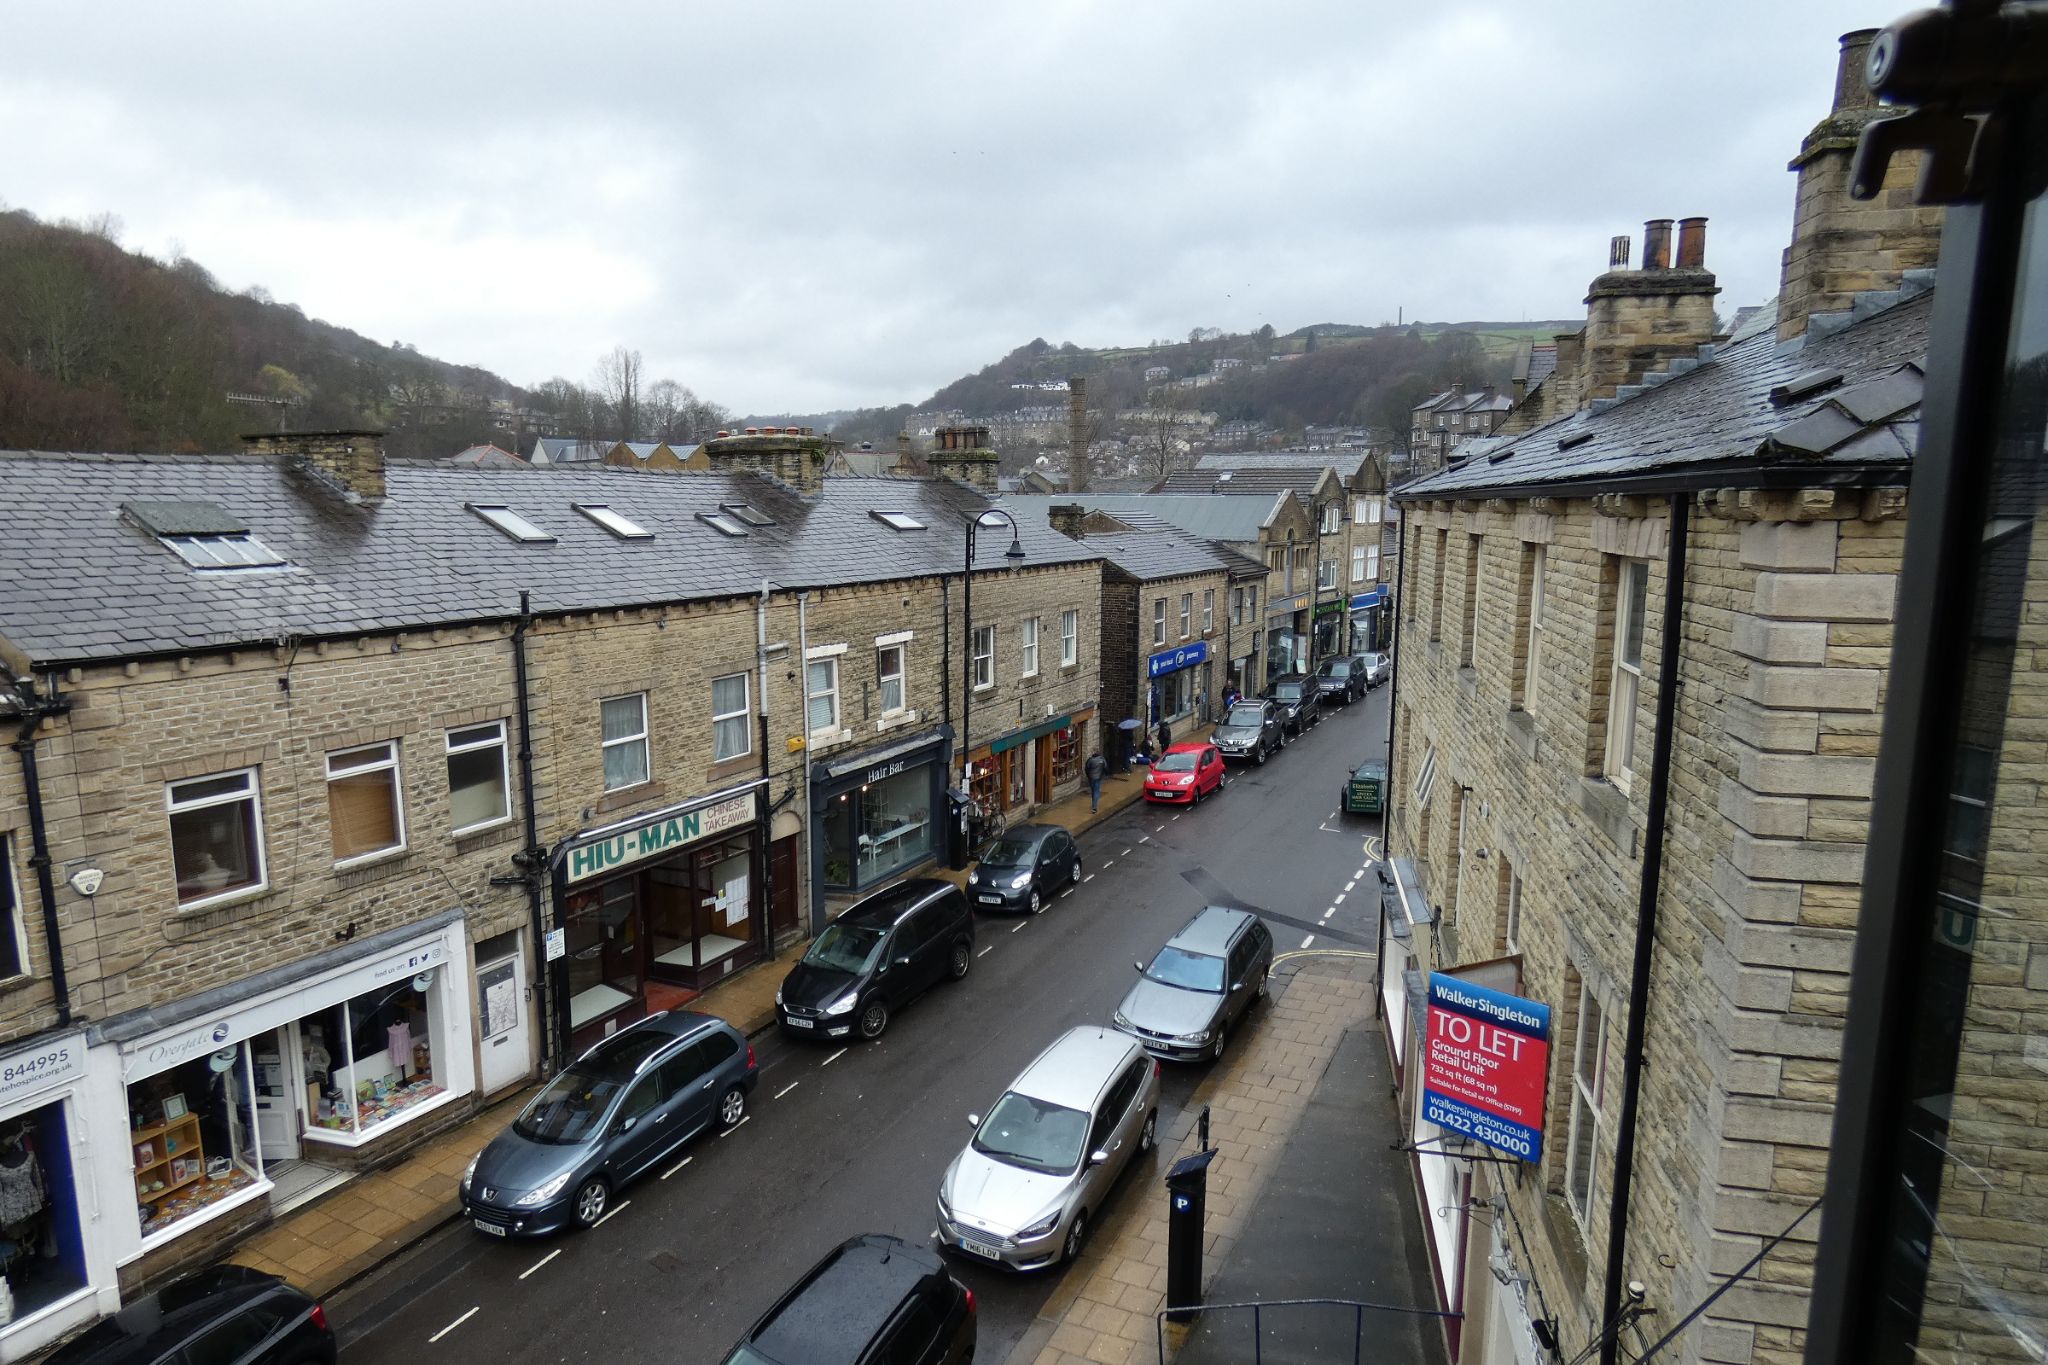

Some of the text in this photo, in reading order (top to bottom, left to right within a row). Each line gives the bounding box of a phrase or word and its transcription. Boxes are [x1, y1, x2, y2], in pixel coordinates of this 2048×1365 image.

[867, 760, 904, 784] Hair Bar
[704, 808, 750, 833] TAKEAWAY
[707, 796, 746, 819] CHINESE
[573, 811, 700, 877] HIU-MAN
[1434, 1010, 1527, 1062] TO LET
[4, 1048, 69, 1081] 844995
[1431, 1049, 1485, 1076] Retail Unit
[1432, 1039, 1499, 1070] Ground Floor
[1431, 1063, 1497, 1095] 732 sq ft (68 sq m)
[1429, 1076, 1452, 1089] Suitable
[1452, 1084, 1461, 1093] for
[1462, 1087, 1478, 1099] Retail
[1485, 1096, 1503, 1109] Office
[1504, 1103, 1522, 1116] (STPP)
[1429, 1106, 1530, 1155] 01422 430000
[1430, 1095, 1531, 1141] walkersingleton.co.uk
